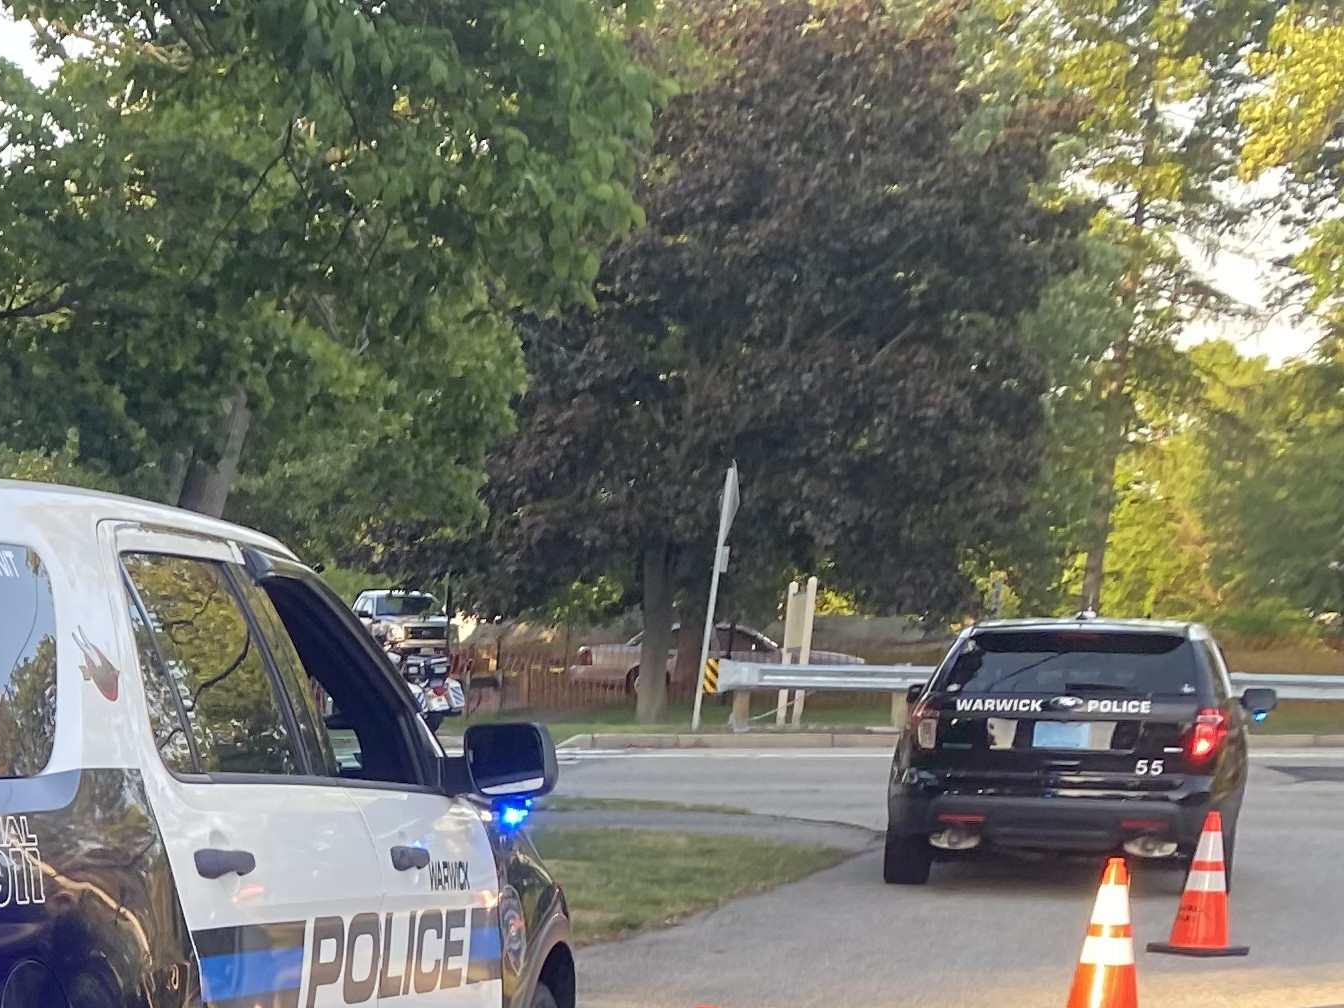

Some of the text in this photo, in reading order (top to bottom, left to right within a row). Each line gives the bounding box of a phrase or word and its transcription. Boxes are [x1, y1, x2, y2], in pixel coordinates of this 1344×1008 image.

[956, 698, 1043, 712] WARWICK
[1087, 699, 1151, 713] POLICE
[1135, 759, 1164, 775] 55
[428, 860, 470, 891] WARWICK
